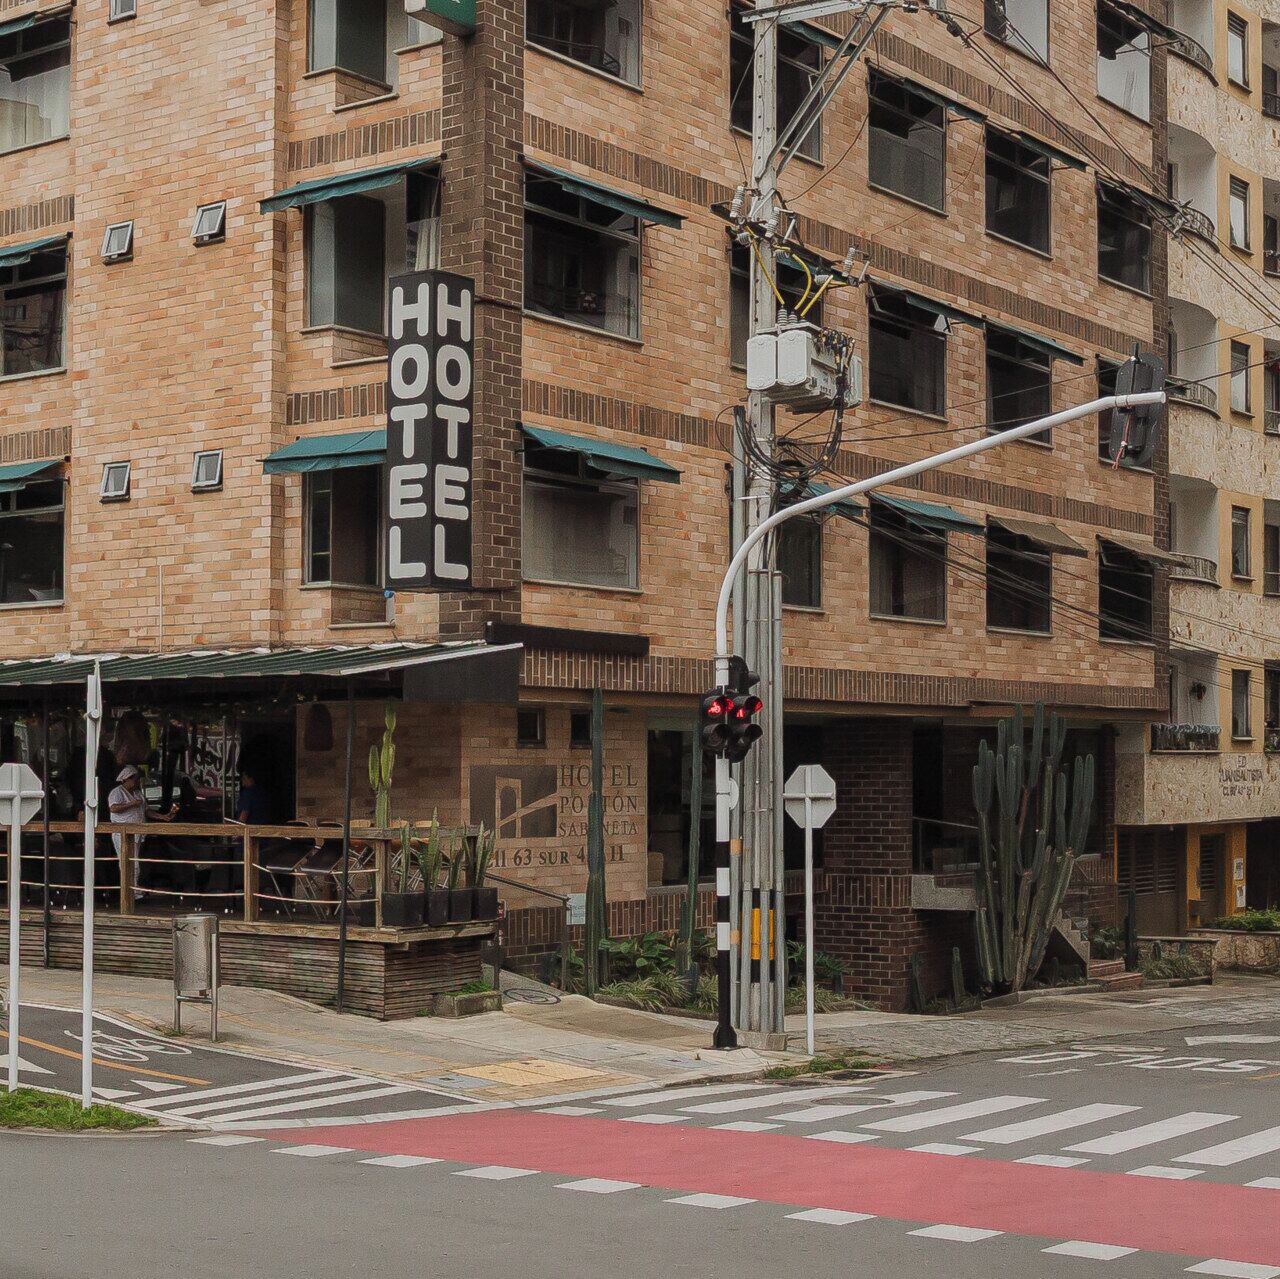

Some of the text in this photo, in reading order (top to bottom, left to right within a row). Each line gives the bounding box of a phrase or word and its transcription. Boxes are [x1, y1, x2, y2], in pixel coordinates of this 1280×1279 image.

[389, 282, 429, 580] HOTEL
[434, 282, 471, 580] HOTEL
[559, 763, 639, 788] HOEL
[559, 790, 639, 814] POTÓN
[558, 820, 639, 838] SABNETA
[513, 848, 532, 867] 63
